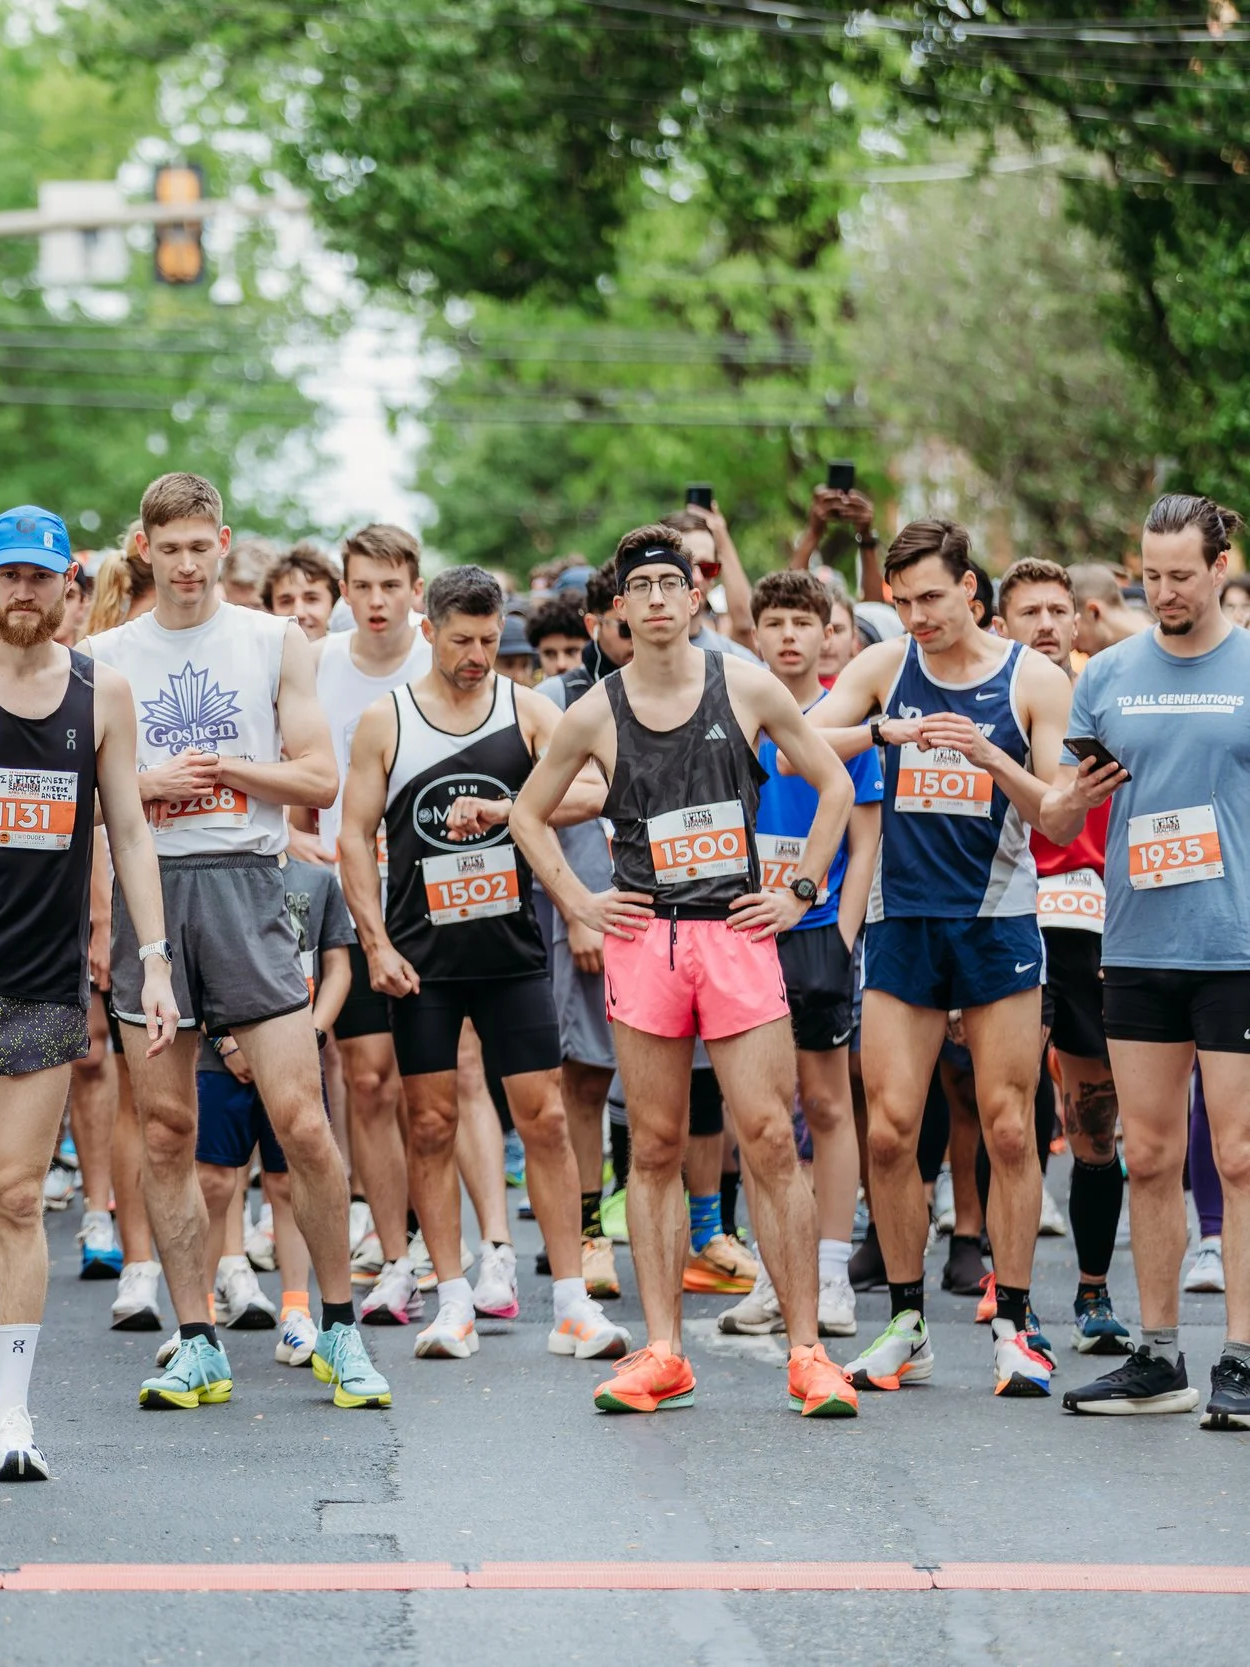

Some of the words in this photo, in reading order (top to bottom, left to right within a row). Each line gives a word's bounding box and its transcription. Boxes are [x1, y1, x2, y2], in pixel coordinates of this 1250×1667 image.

[1116, 695, 1132, 707] TO
[1134, 694, 1156, 705] ALL
[1158, 693, 1245, 706] GENERATIONS
[149, 722, 237, 745] Goshen
[448, 784, 478, 796] RUN
[913, 771, 976, 798] 1501
[660, 832, 739, 865] 1500
[1138, 838, 1205, 871] 1935
[760, 863, 796, 888] 176
[438, 875, 509, 907] 1502
